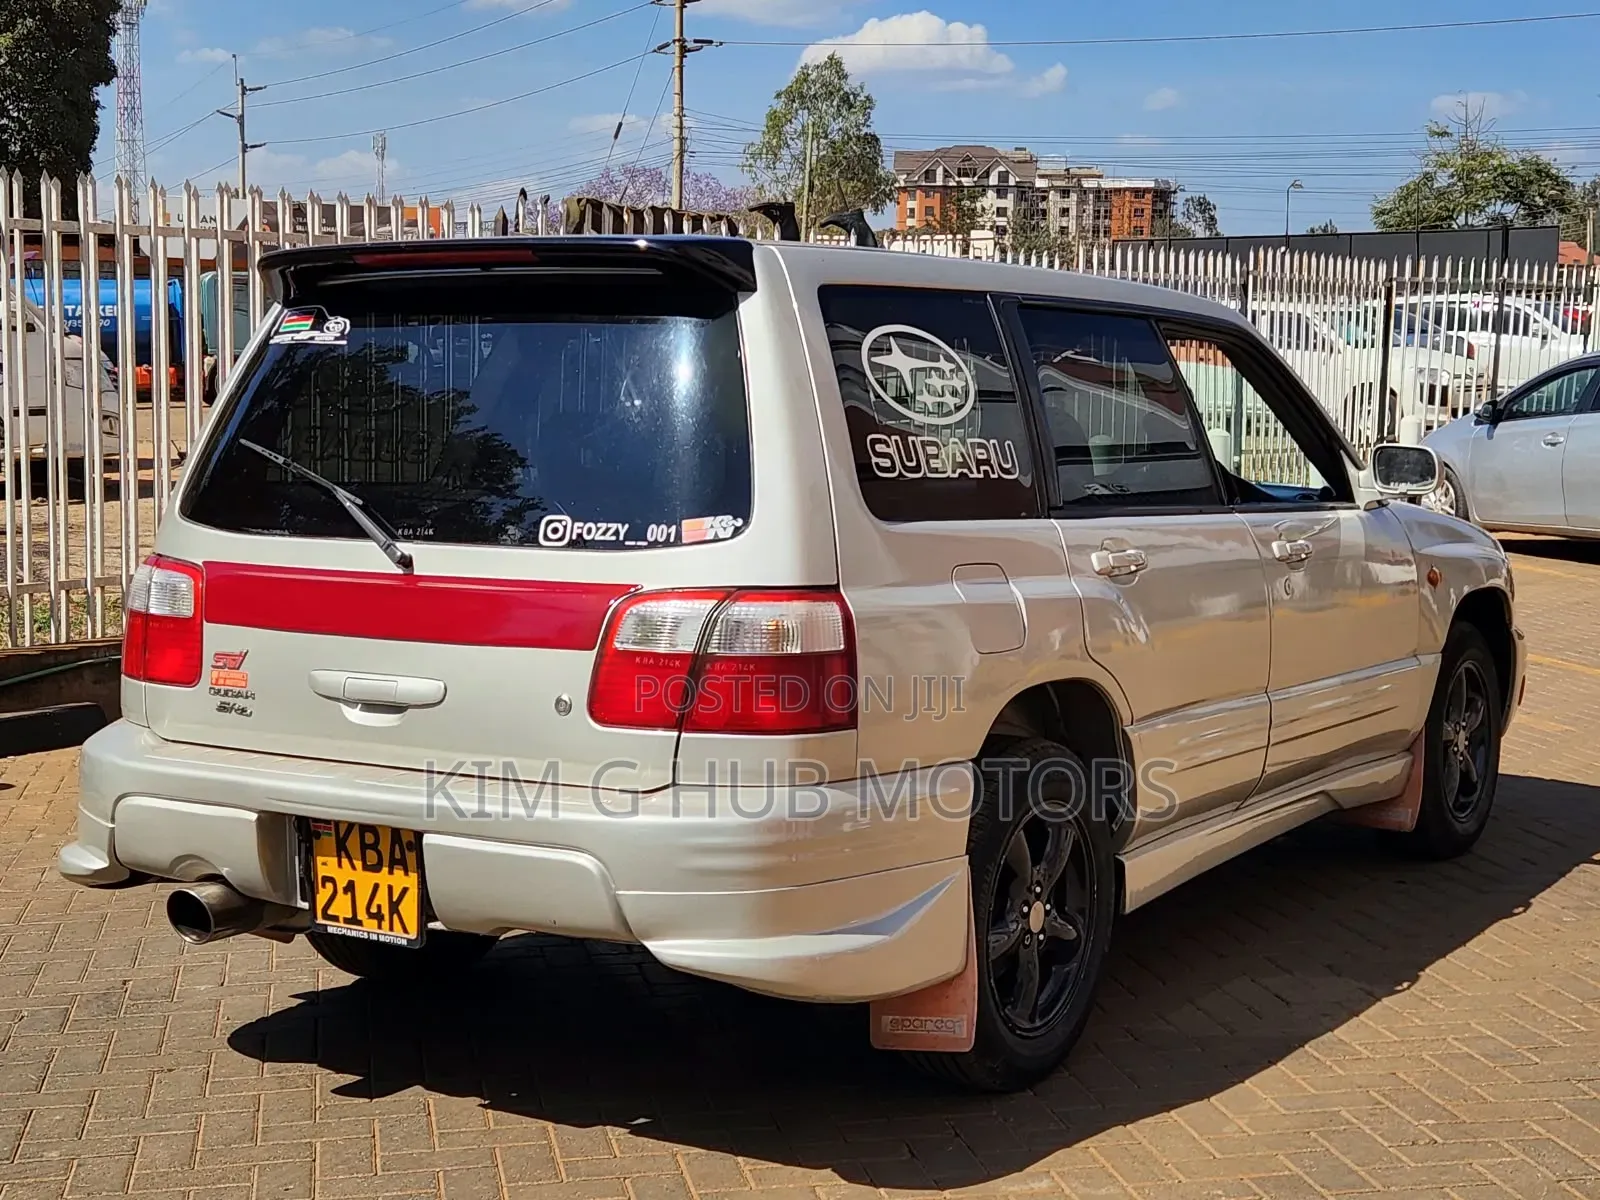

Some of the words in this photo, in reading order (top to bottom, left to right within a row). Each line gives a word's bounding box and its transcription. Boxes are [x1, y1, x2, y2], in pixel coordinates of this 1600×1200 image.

[866, 434, 1020, 480] SUBARU
[333, 819, 410, 877] KBA
[320, 875, 411, 936] 214K
[326, 925, 369, 939] MECHANICS
[369, 932, 379, 941] IN
[379, 934, 408, 946] MOTION
